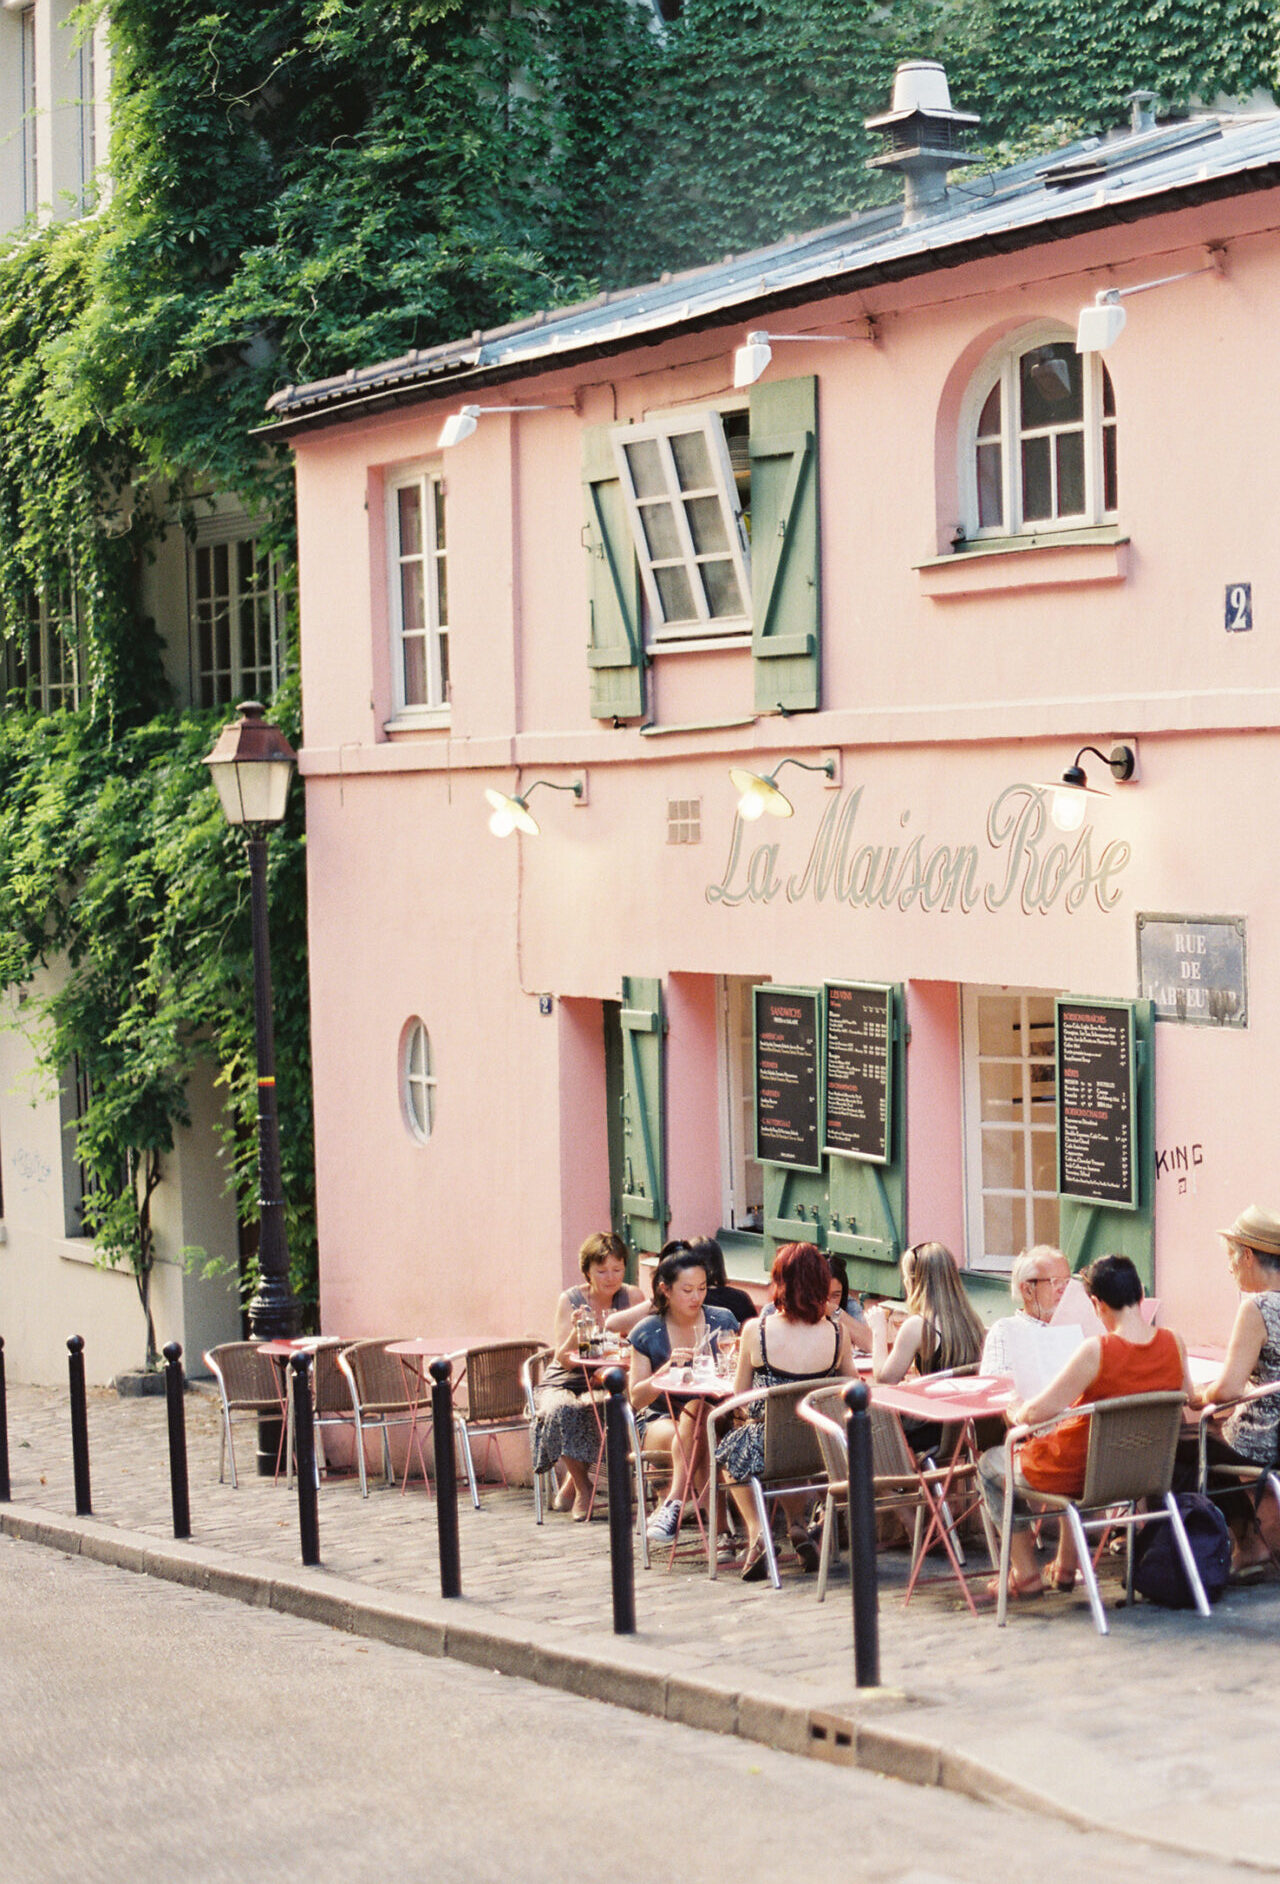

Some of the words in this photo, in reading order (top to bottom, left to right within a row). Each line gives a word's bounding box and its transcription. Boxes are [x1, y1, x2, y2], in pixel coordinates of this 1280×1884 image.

[1231, 587, 1246, 628] 2
[705, 808, 782, 907] La
[786, 783, 981, 914] Maison
[984, 782, 1131, 915] Rose
[1175, 934, 1206, 954] RUE
[1181, 961, 1201, 980] DE
[1154, 1144, 1202, 1180] KING
